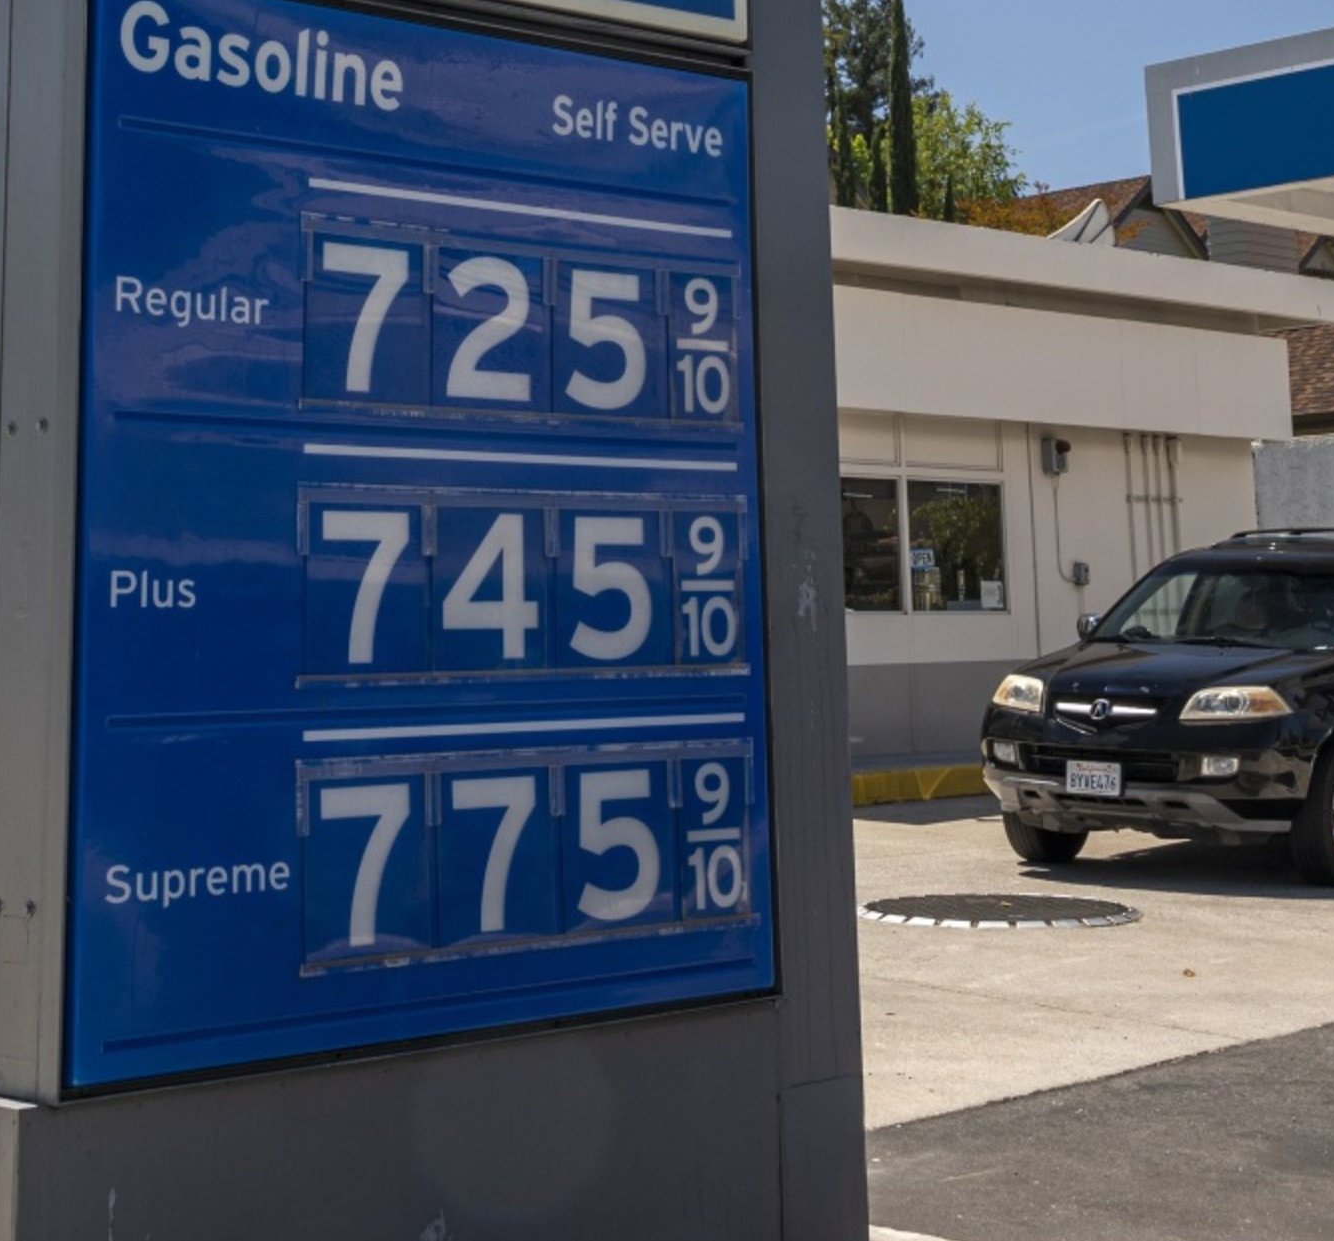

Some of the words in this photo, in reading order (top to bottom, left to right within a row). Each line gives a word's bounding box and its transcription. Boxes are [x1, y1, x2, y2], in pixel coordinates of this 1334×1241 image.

[120, 0, 404, 112] Gasoline
[552, 94, 618, 142] Self
[628, 105, 723, 157] Serve
[115, 275, 269, 328] Regular
[322, 242, 646, 410] 725
[684, 277, 719, 336] 9
[676, 354, 731, 414] 10
[689, 515, 724, 575] 9
[110, 569, 197, 609] Plus
[322, 510, 652, 664] 745
[681, 596, 737, 657] 10
[694, 762, 730, 825] 9
[104, 861, 290, 908] Supreme
[321, 770, 660, 948] 775
[688, 845, 743, 910] 10
